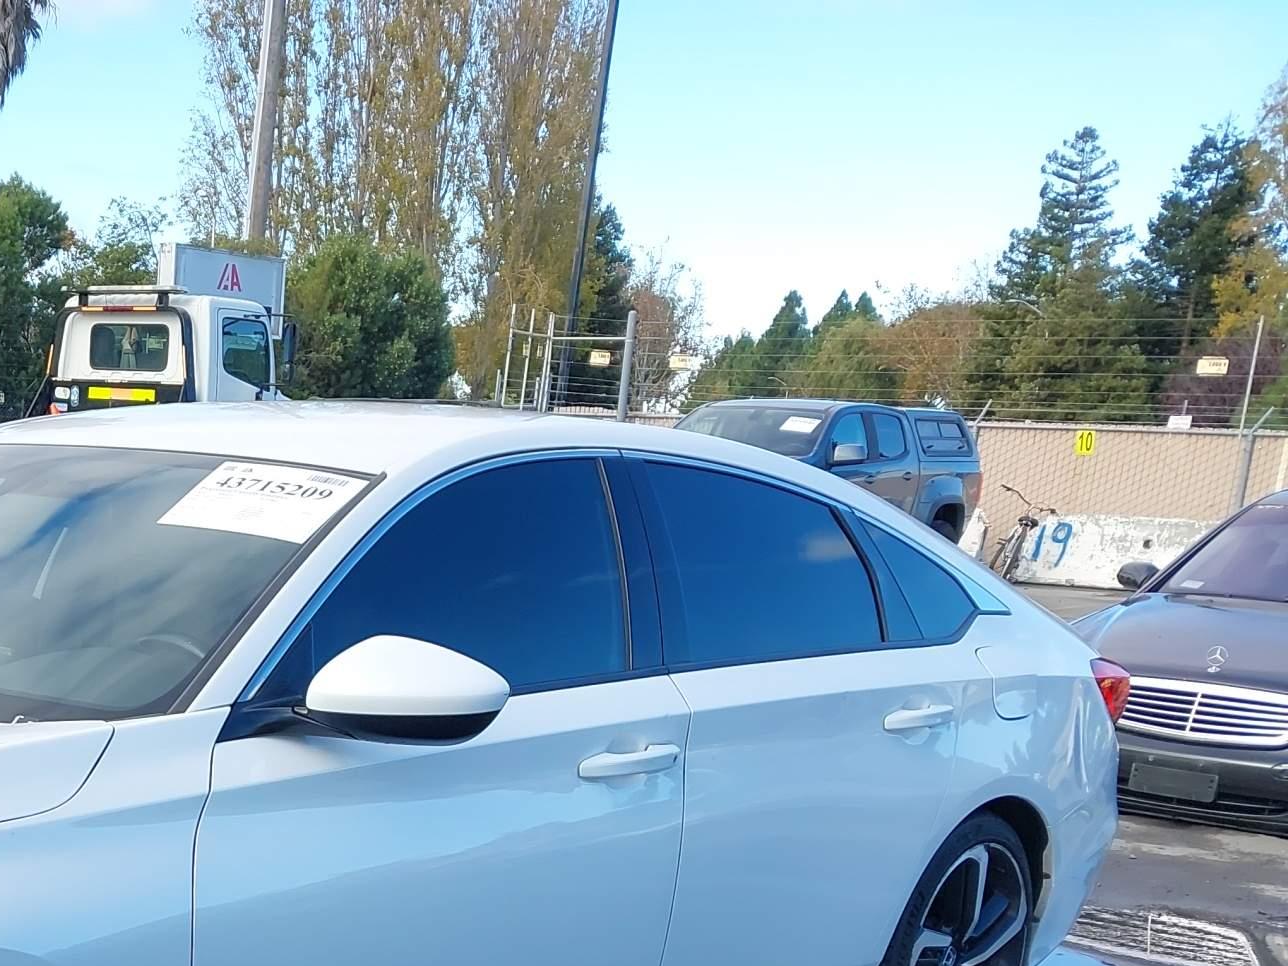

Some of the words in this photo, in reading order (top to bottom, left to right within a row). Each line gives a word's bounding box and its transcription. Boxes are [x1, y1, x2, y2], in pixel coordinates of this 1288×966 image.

[1078, 431, 1093, 451] 10
[215, 475, 334, 501] 43715209
[1030, 520, 1074, 567] 19
